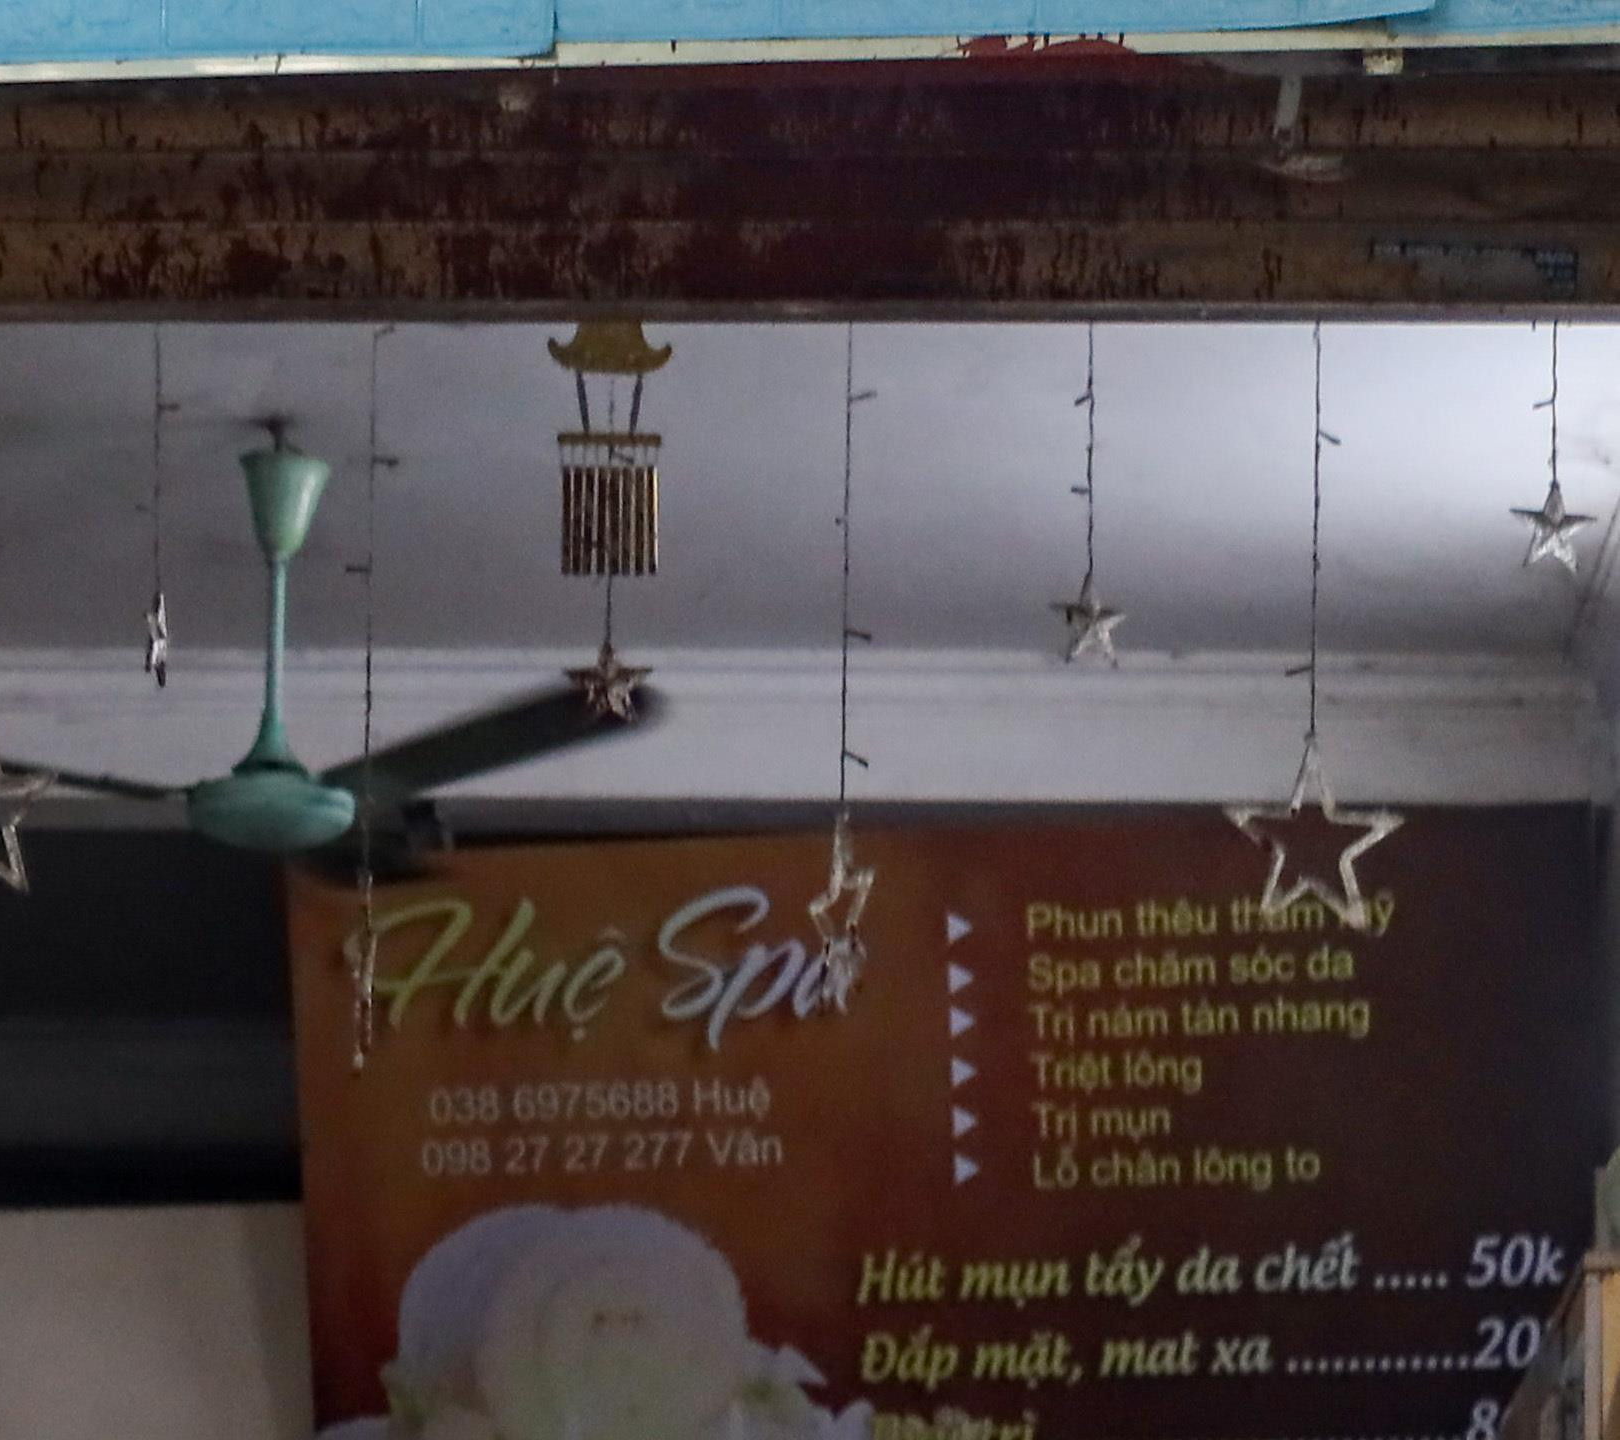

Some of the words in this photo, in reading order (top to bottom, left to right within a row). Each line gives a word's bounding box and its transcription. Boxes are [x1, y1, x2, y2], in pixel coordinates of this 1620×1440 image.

[1027, 901, 1123, 941] Phun
[345, 897, 627, 1041] Huệ
[1028, 953, 1101, 998] Spa
[1114, 950, 1216, 990] chăm
[1230, 946, 1295, 984] sóc
[1307, 943, 1355, 982] da
[1252, 996, 1370, 1040] nhang
[1124, 1050, 1204, 1096] lông
[429, 1084, 501, 1126] 038
[512, 1077, 679, 1123] 6975688
[693, 1073, 772, 1123] Huệ
[1092, 1106, 1171, 1143] mụn
[420, 1137, 492, 1177] 098
[503, 1134, 551, 1176] 27
[562, 1131, 611, 1174] 27
[622, 1128, 694, 1172] 277
[705, 1125, 785, 1169] Vân
[1092, 1149, 1181, 1189] chân
[1194, 1147, 1273, 1193] lông
[1285, 1148, 1321, 1183] to
[857, 1247, 946, 1306] Hút
[960, 1258, 1071, 1311] mụn
[1177, 1245, 1241, 1296] da
[1254, 1230, 1362, 1292] chết
[1466, 1232, 1566, 1289] 50k
[861, 1322, 959, 1393] Đắp
[1210, 1334, 1273, 1375] xa
